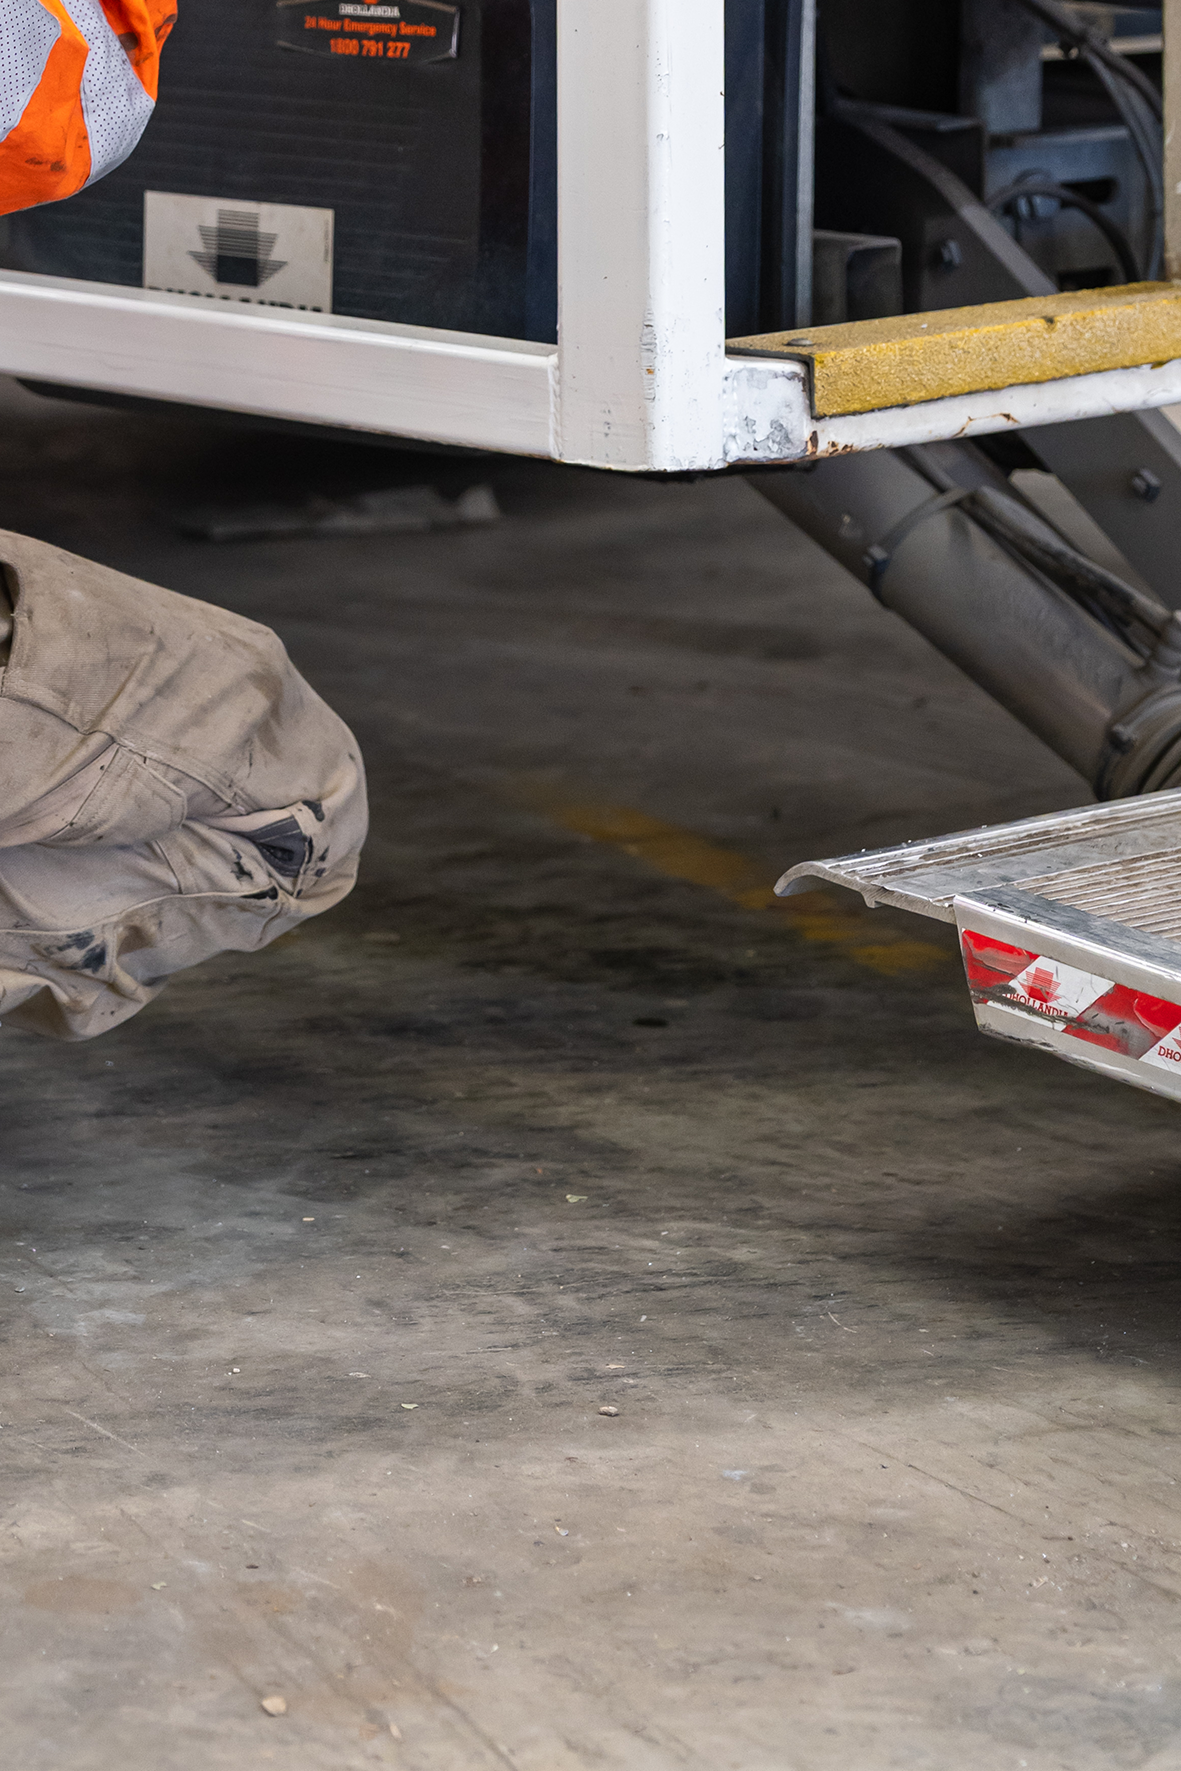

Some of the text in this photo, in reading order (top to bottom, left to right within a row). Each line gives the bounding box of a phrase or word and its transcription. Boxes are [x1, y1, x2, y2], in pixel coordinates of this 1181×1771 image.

[304, 15, 437, 38] 24 Hour Emergency Service
[330, 38, 411, 59] 1800 791 277
